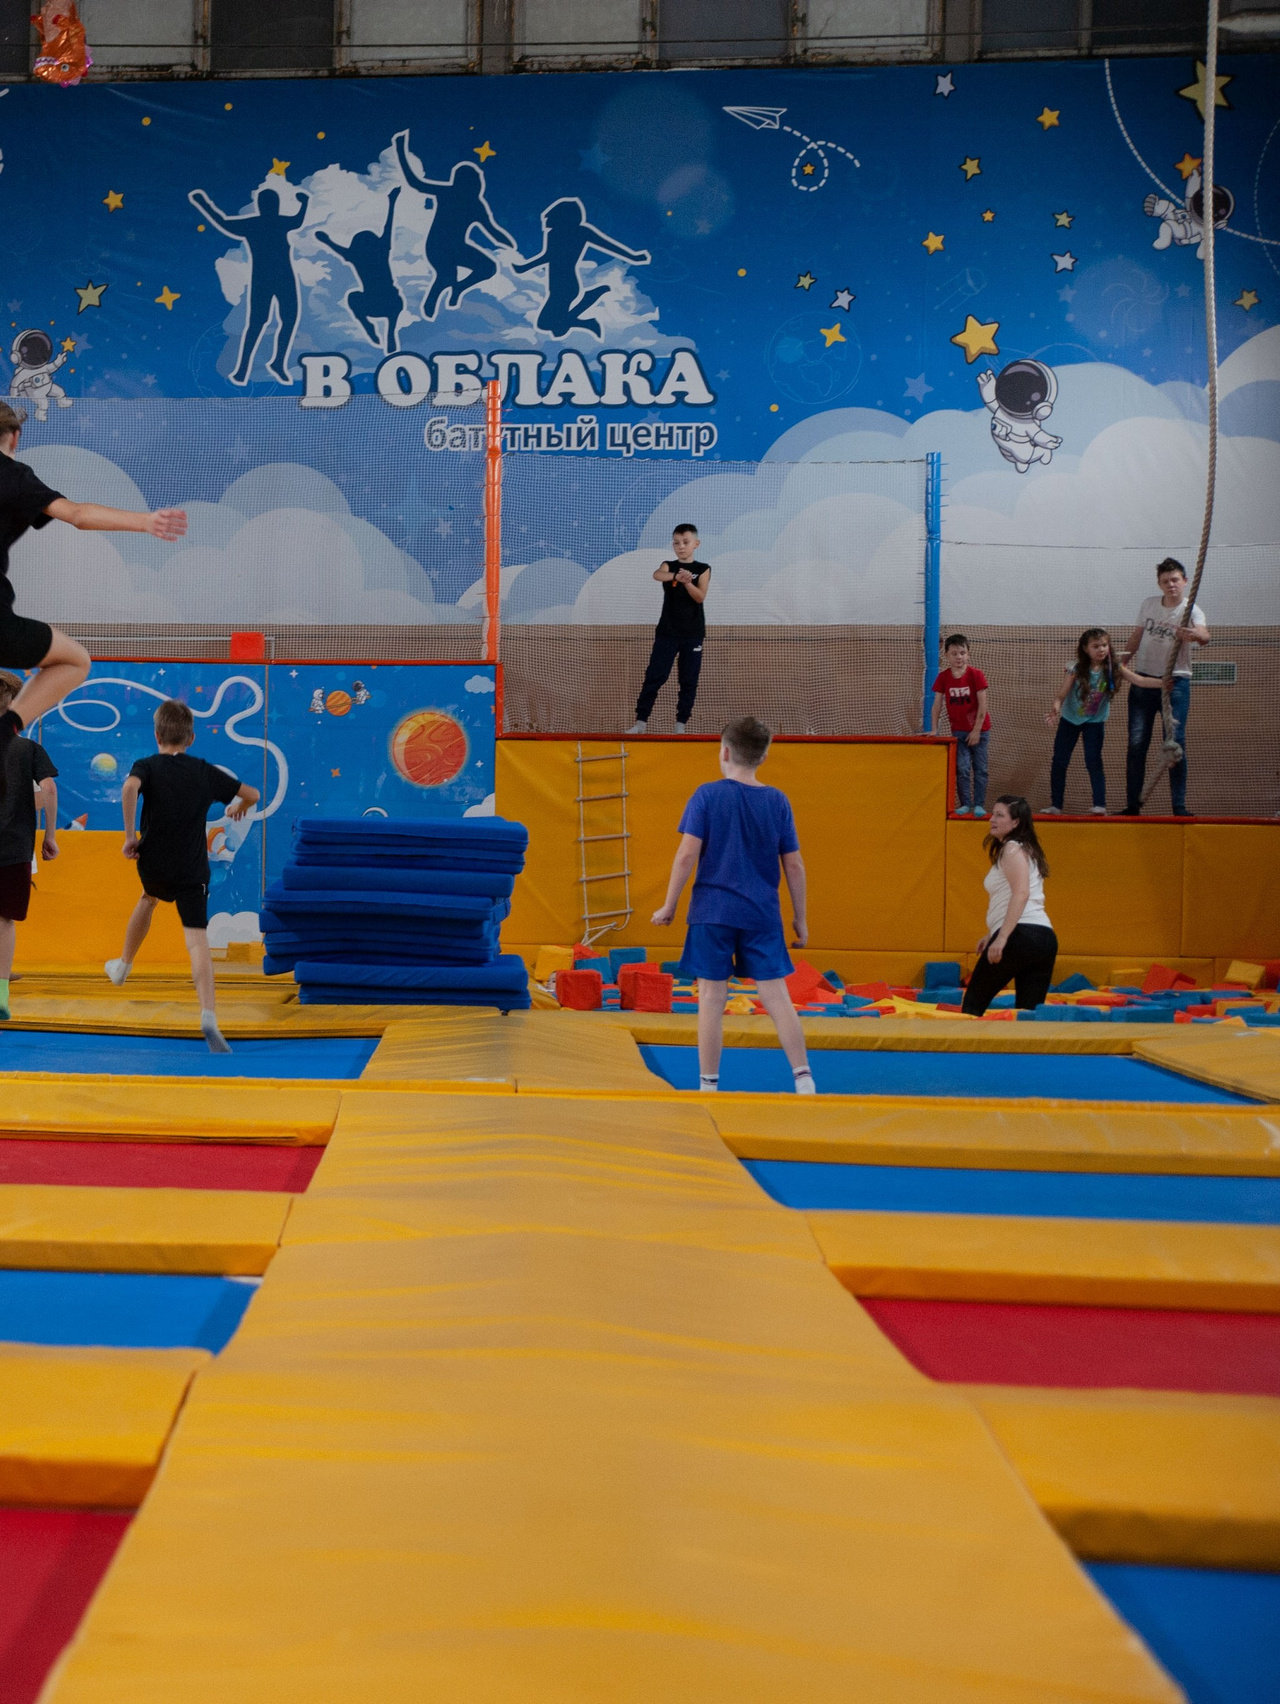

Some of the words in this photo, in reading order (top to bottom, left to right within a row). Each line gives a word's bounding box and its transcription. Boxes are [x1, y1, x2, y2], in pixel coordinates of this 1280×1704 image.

[298, 352, 352, 409] В
[375, 350, 716, 409] ОБЛАКА
[424, 415, 599, 450] баттный
[606, 422, 718, 457] центр
